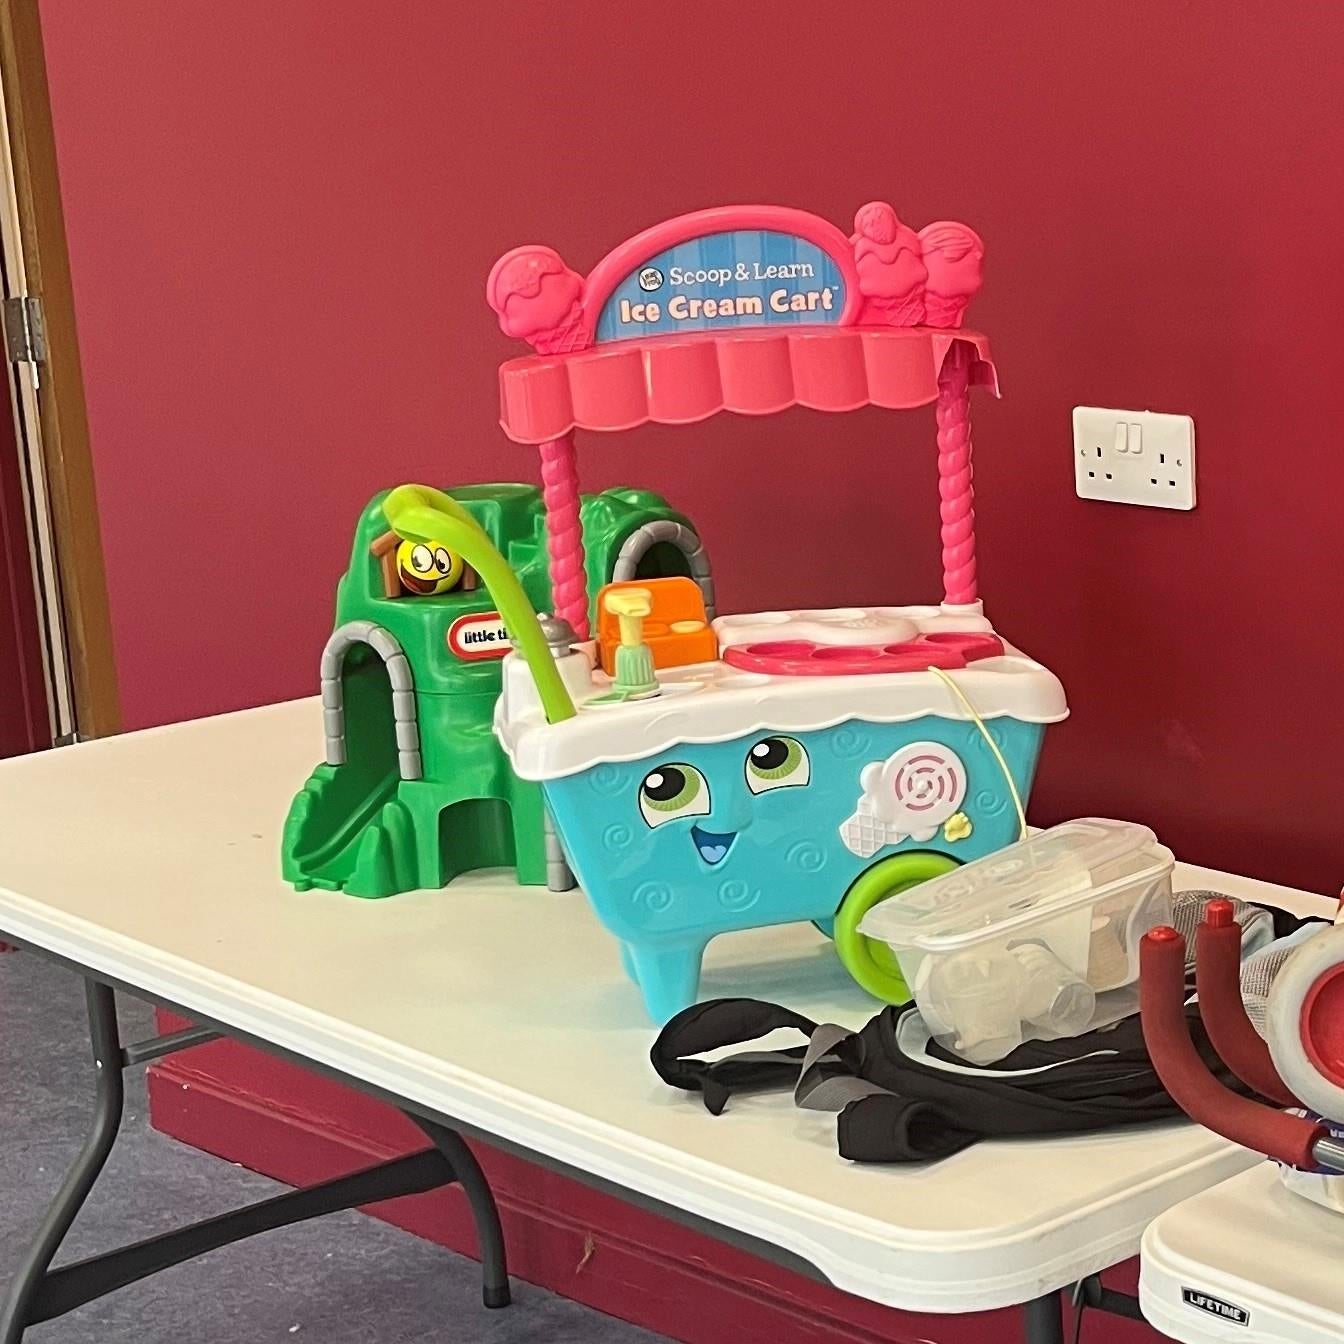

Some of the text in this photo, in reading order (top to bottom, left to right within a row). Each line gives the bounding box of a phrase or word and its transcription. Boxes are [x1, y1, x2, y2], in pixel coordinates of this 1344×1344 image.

[669, 266, 731, 287] Scoop
[735, 263, 750, 281] &
[753, 262, 815, 280] Learn
[620, 299, 661, 323] Ice
[668, 295, 763, 320] Cream
[464, 629, 495, 644] little
[1189, 1292, 1242, 1320] LIFETIME
